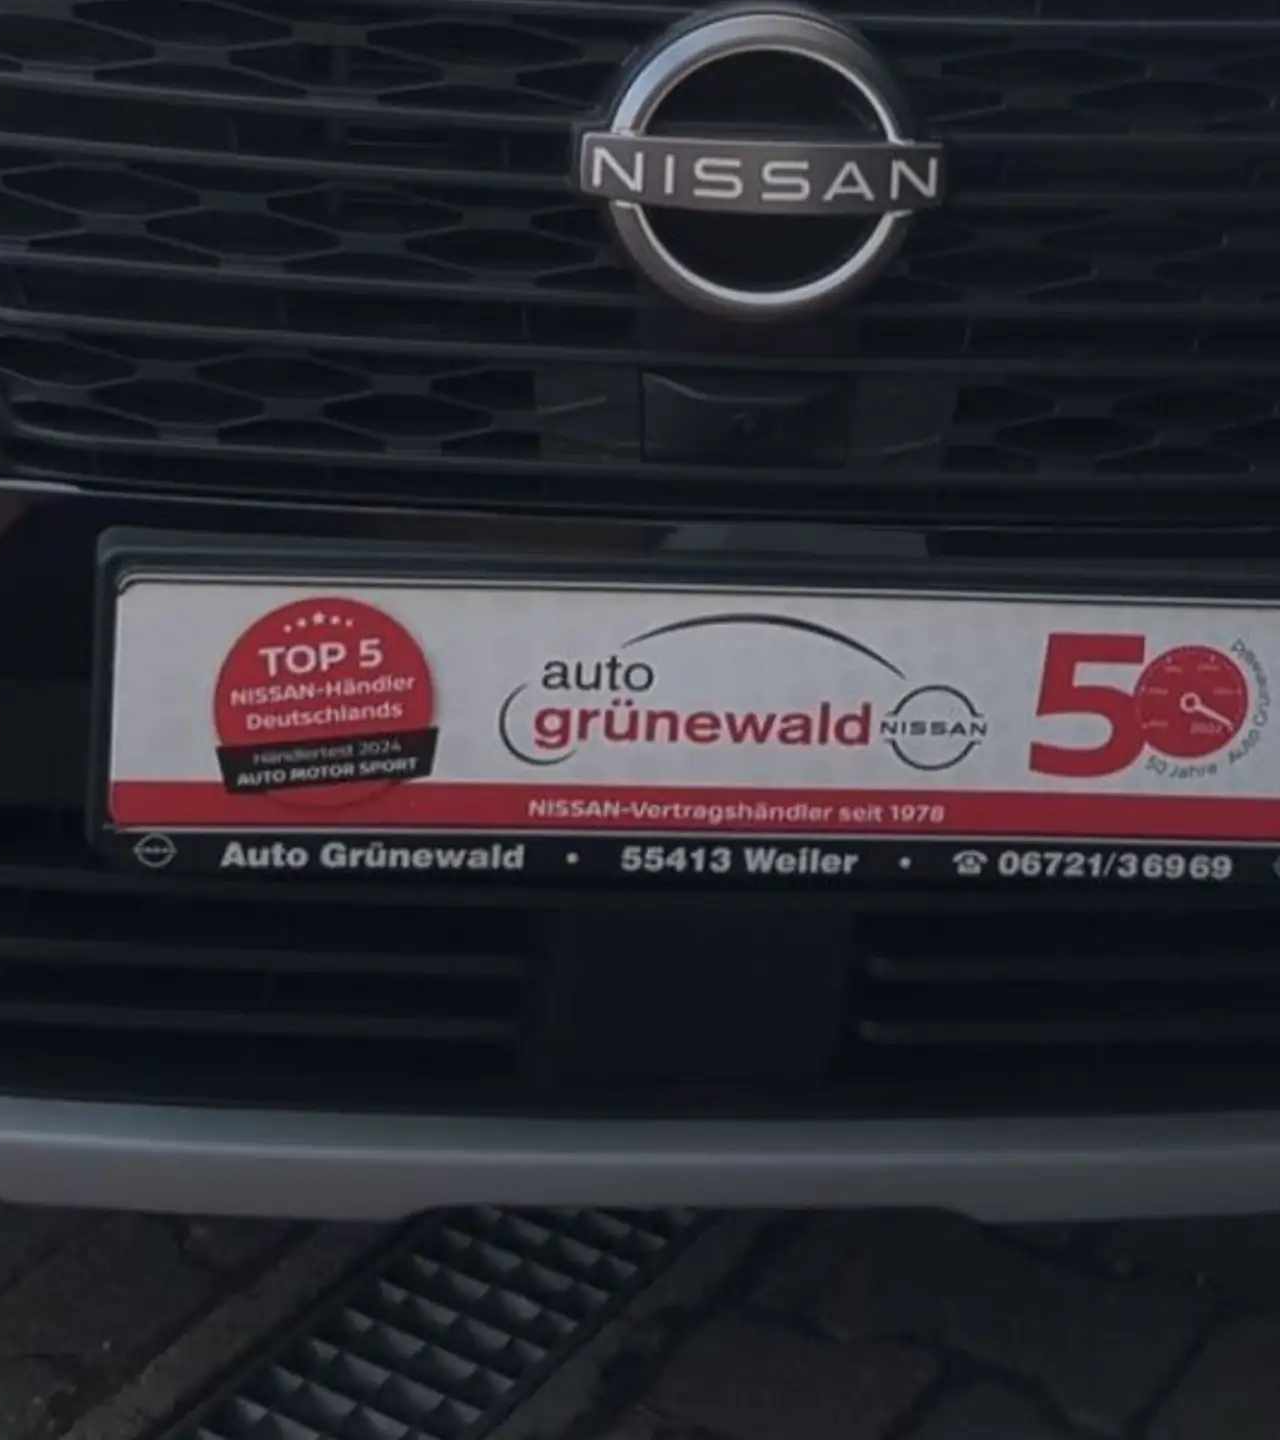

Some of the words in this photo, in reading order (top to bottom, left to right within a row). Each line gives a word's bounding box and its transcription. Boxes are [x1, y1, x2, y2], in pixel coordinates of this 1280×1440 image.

[591, 146, 938, 201] NISSAN
[258, 642, 347, 678] TOP
[358, 637, 384, 668] 5
[542, 655, 654, 692] auto
[229, 673, 417, 707] NISSAN-Händler
[245, 701, 404, 731] Deutschlands
[533, 699, 873, 750] grünewald
[879, 720, 989, 738] NISSAN
[236, 767, 286, 786] AUTO
[289, 763, 355, 780] MOTOR
[359, 756, 419, 776] SPORT
[528, 799, 833, 824] NISSAN-Vertragshändler
[838, 803, 884, 824] seit
[890, 805, 946, 824] 1978
[220, 842, 310, 869] Auto
[320, 838, 525, 871] Grünewald
[620, 845, 732, 873] 55413
[743, 846, 859, 876] Weiler
[997, 851, 1234, 879] 06721/36969
